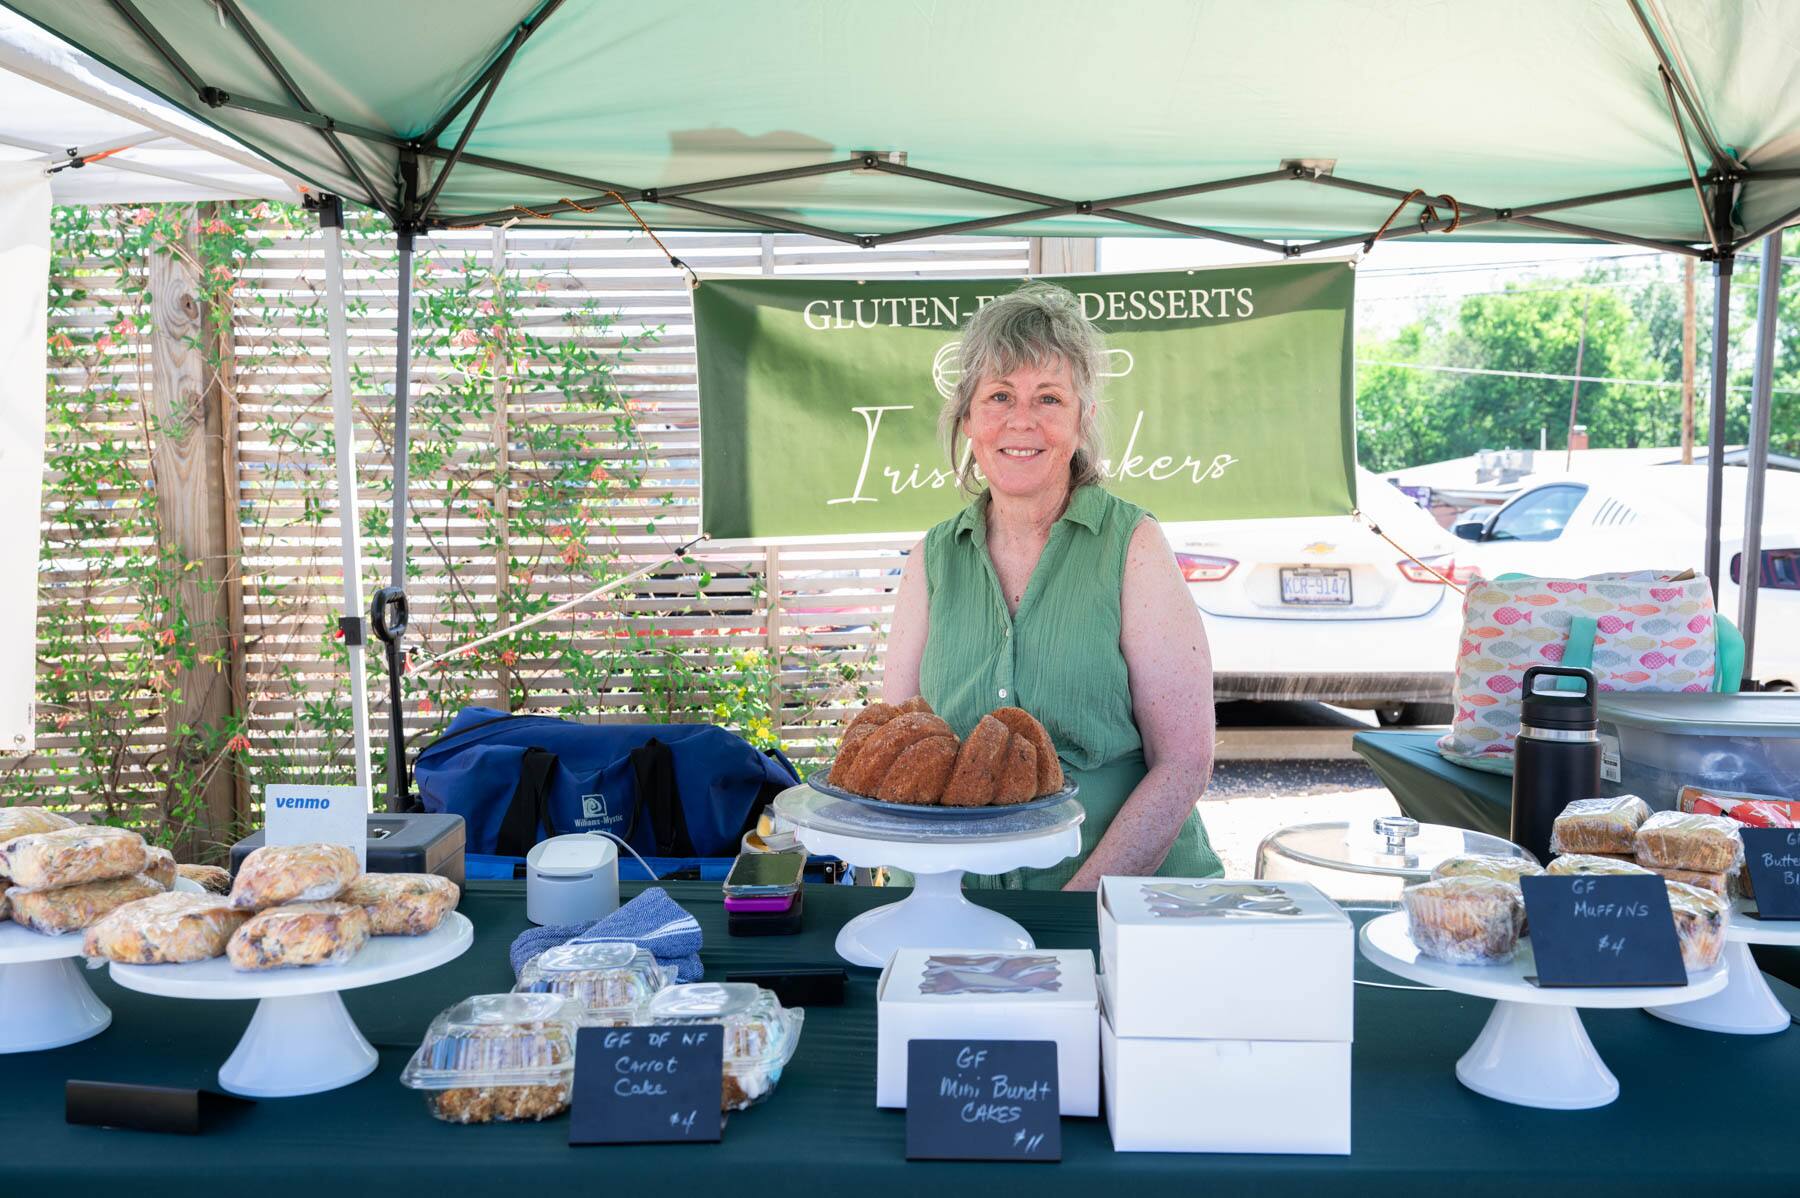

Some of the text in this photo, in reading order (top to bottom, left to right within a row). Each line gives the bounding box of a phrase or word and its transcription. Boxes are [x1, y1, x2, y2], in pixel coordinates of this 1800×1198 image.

[1077, 287, 1254, 321] DESSERTS
[1094, 410, 1240, 484] akers
[1284, 577, 1347, 595] KCR-9147
[276, 797, 330, 810] venmo
[1572, 878, 1597, 895] GF
[603, 1031, 708, 1049] GF DF NF
[956, 1046, 988, 1069] GF
[614, 1077, 668, 1097] Cake
[991, 1074, 1051, 1101] Bundt
[961, 1101, 1022, 1124] CAKES
